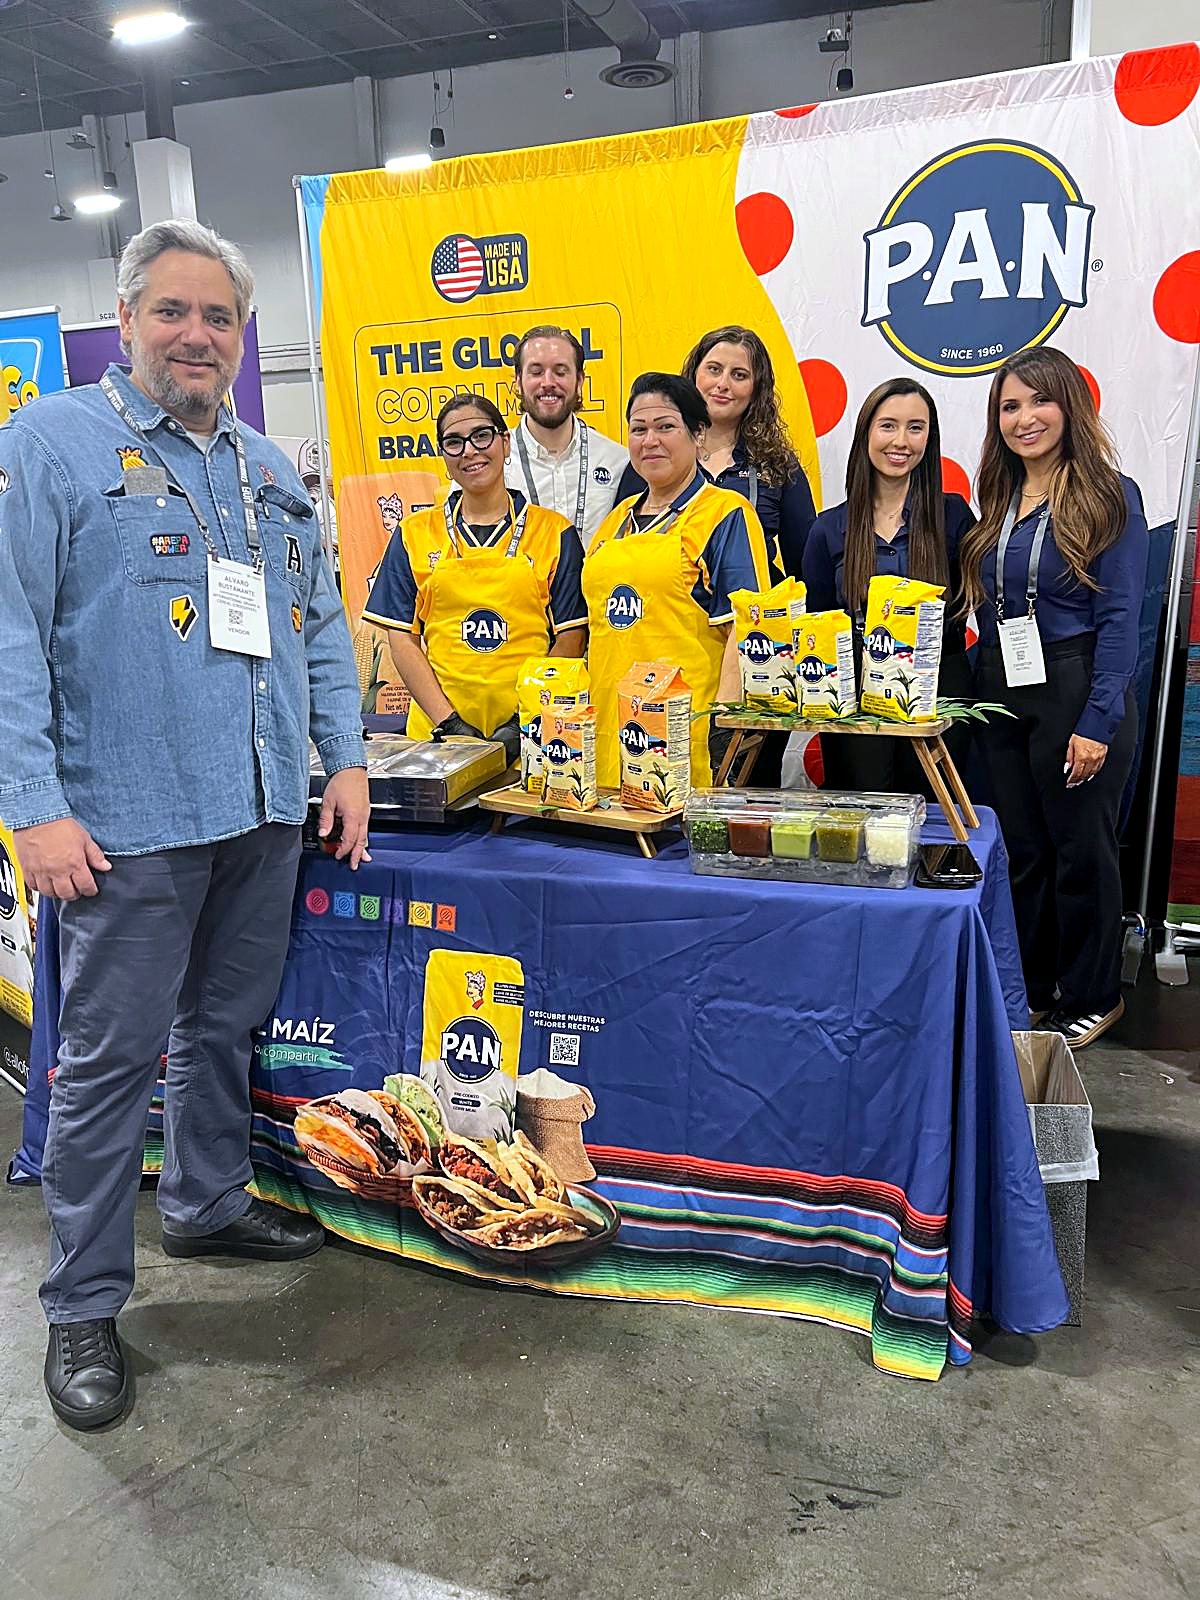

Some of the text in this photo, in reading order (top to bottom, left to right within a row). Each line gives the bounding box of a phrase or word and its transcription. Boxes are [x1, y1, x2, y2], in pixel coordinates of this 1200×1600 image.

[484, 241, 521, 258] MADE IN
[486, 256, 524, 287] USA
[371, 327, 603, 375] THE GLOL
[940, 343, 1004, 360] SINCE 1960
[497, 376, 604, 417] ML
[151, 535, 189, 546] #AREPA
[155, 545, 187, 554] POWER
[284, 534, 302, 574] A
[224, 575, 249, 588] ALVARO
[218, 582, 255, 597] BUSTAMANTE
[228, 626, 250, 635] VENDOR
[529, 1010, 606, 1025] DESCUBRE NUESTRAS
[272, 1017, 335, 1044] MAÍZ
[533, 1019, 600, 1032] MEJORES RECETAS
[263, 1047, 319, 1062] compartir
